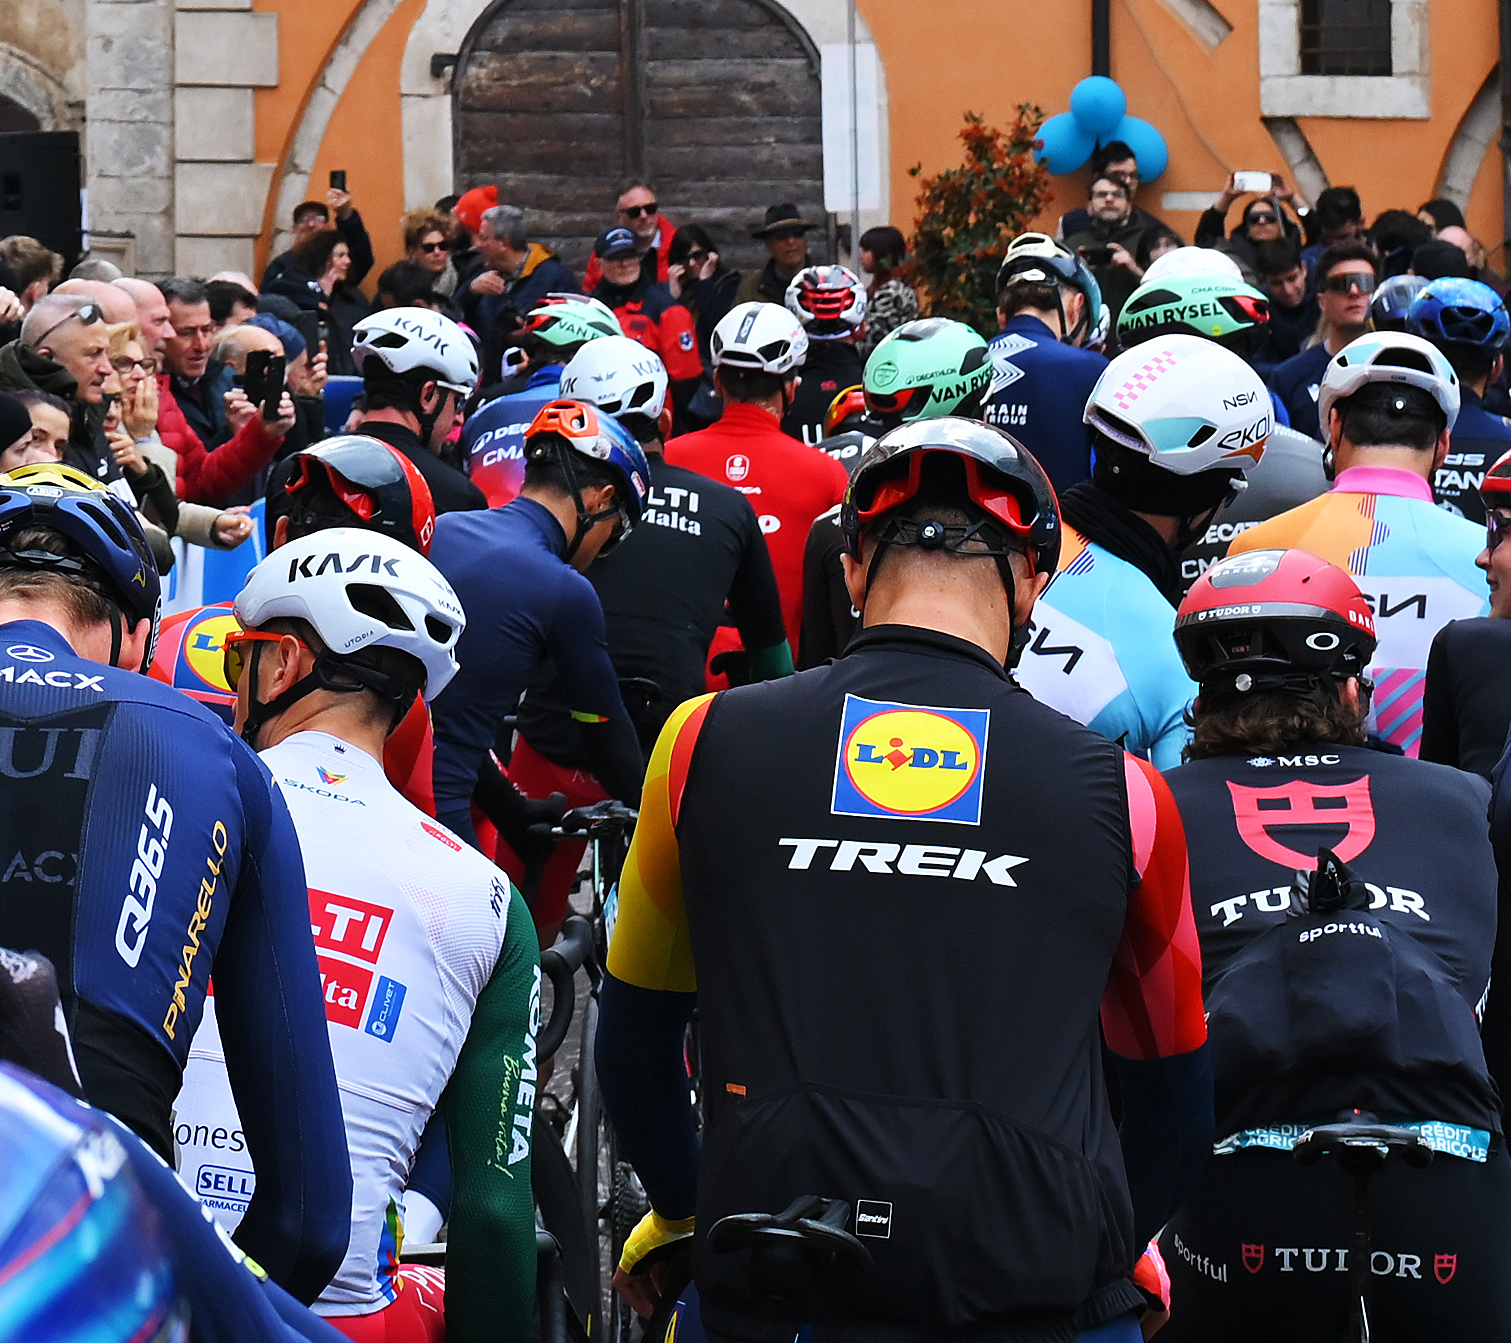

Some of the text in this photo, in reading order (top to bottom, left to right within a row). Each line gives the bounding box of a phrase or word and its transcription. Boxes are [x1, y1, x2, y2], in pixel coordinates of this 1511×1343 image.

[1164, 302, 1224, 324] RYSEL
[395, 317, 450, 357] KASK
[557, 321, 587, 337] VAN
[915, 368, 958, 383] DECATHLON
[932, 381, 967, 404] VAN
[288, 553, 401, 583] KASK
[438, 599, 463, 615] KASK
[1209, 606, 1249, 620] TUDOR
[344, 630, 375, 649] UTOPIA
[1277, 754, 1341, 767] MSC
[778, 837, 1030, 888] TREK
[115, 782, 175, 968] Q36.5
[162, 820, 228, 1041] PINARELLO
[1299, 922, 1383, 943] sportful
[379, 980, 396, 1022] CLIVET
[508, 964, 542, 1166] KOMETA
[200, 1171, 253, 1196] SELL
[1173, 1233, 1228, 1284] sportful
